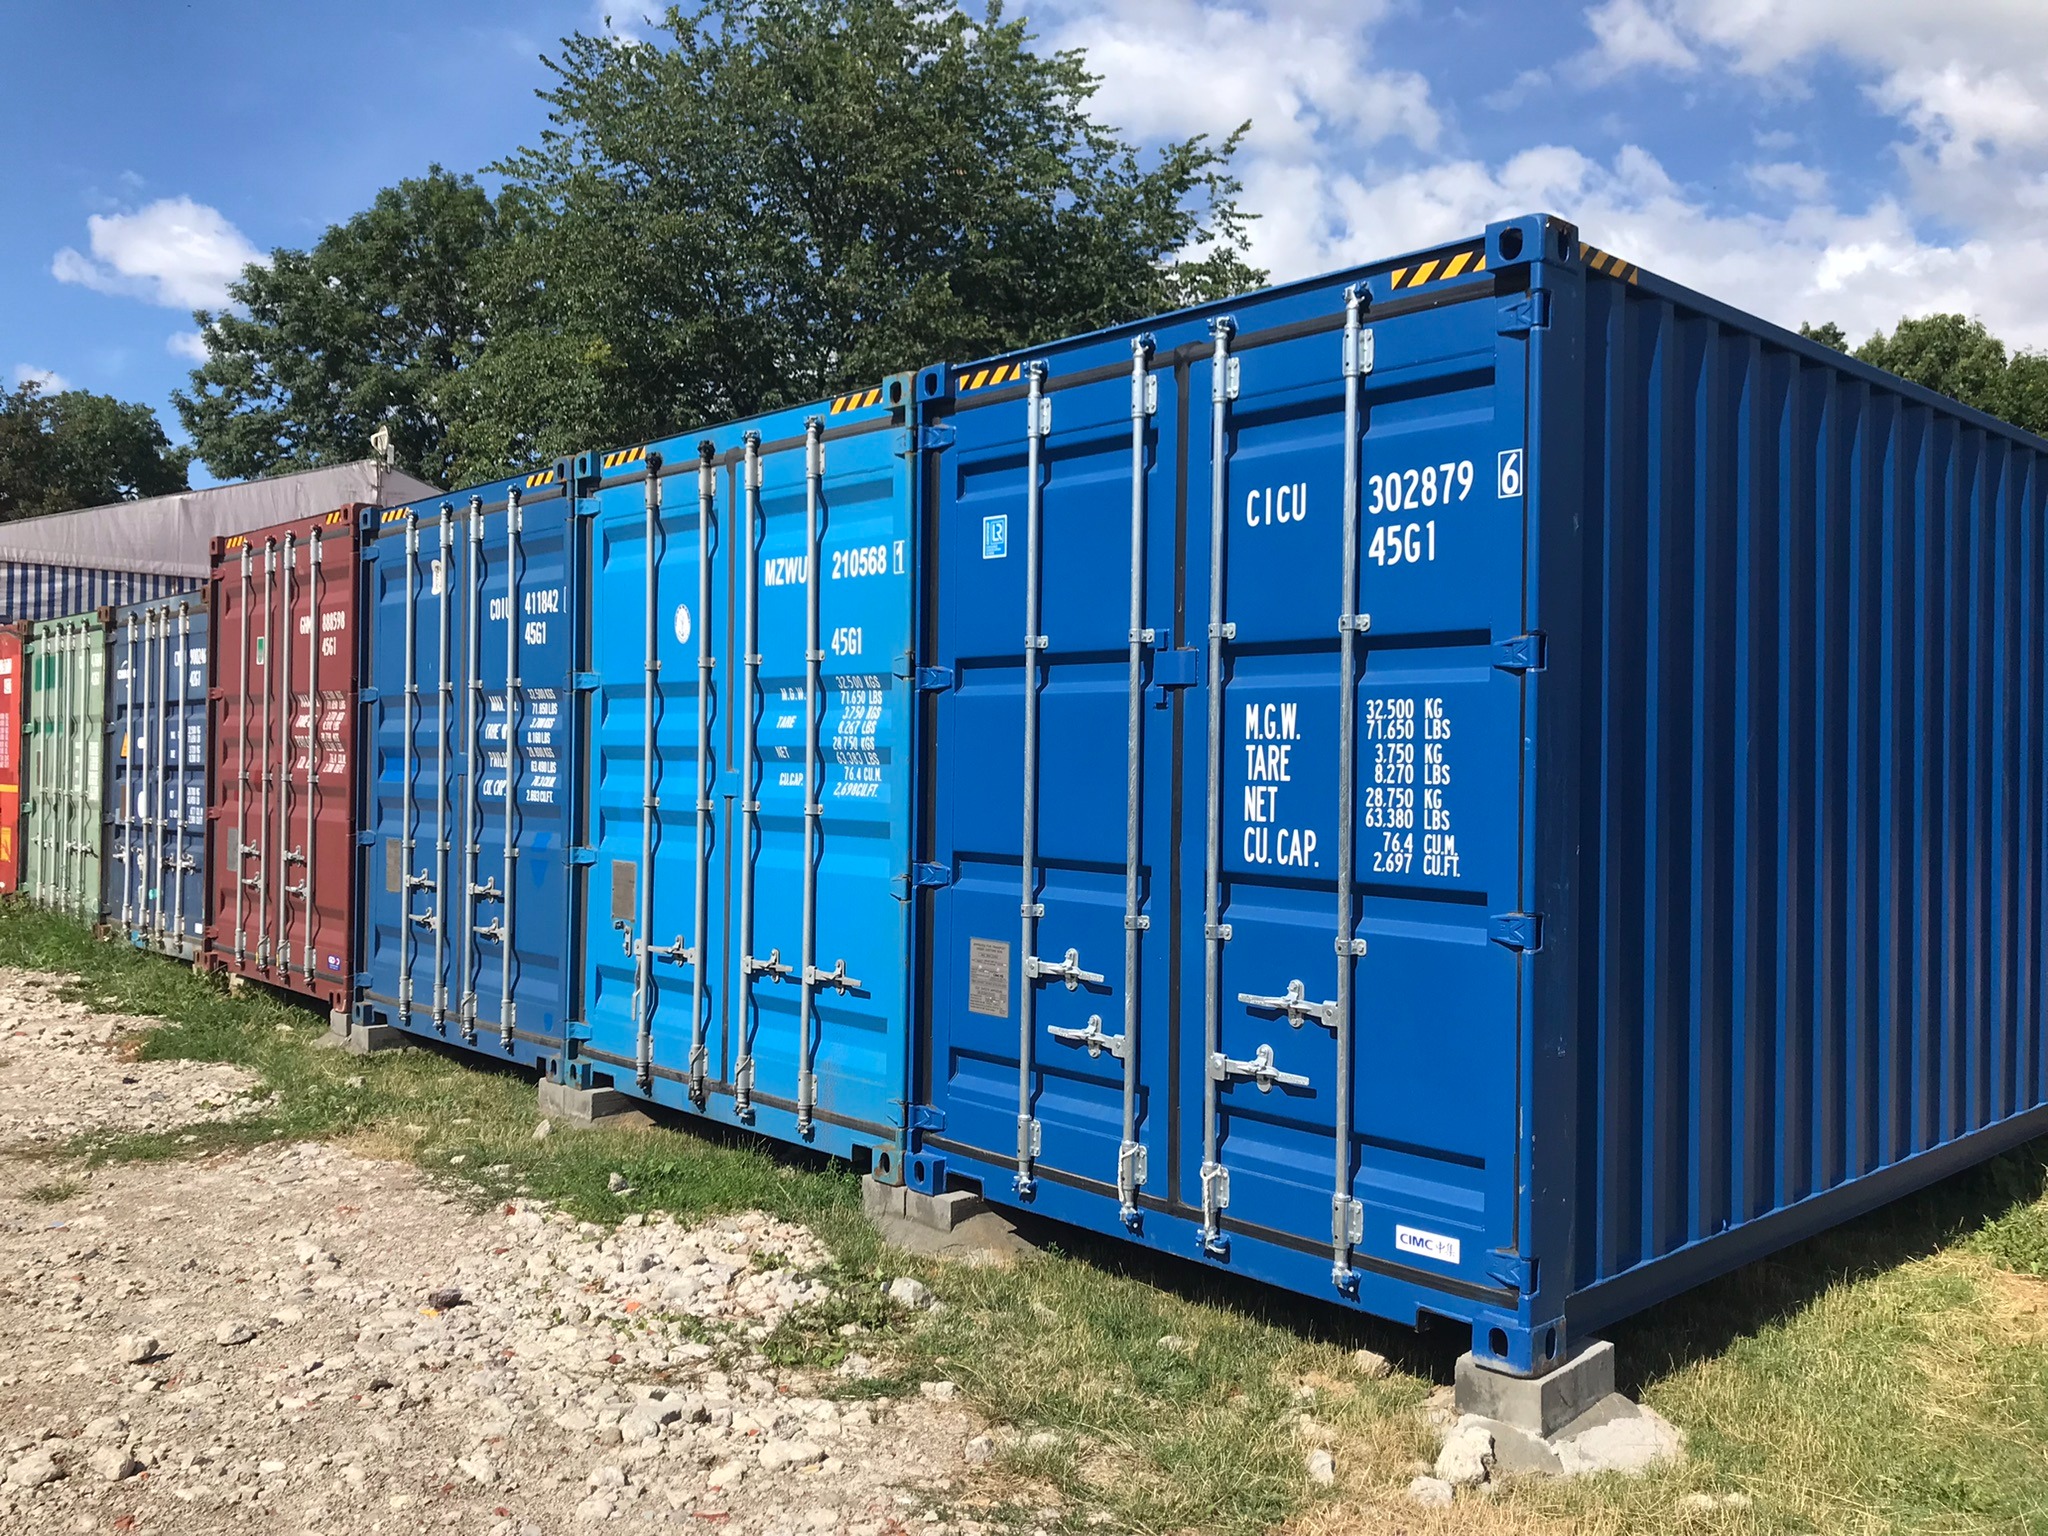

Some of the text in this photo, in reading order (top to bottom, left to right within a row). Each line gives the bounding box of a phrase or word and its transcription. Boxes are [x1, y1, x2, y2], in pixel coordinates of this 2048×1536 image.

[1246, 452, 1520, 527] CICU 302879 6
[1368, 520, 1436, 566] 45G1
[765, 555, 808, 586] MZWU
[832, 545, 887, 579] 210568
[525, 589, 559, 615] 411842
[525, 621, 546, 645] 45G1
[831, 627, 862, 655] 45G1
[863, 675, 881, 689] KGS
[781, 687, 807, 701] M.G.W.
[868, 690, 883, 705] LBS
[865, 706, 882, 720] KGS
[1366, 697, 1443, 719] 32,500 KG
[776, 715, 797, 729] TARE
[861, 721, 877, 734] LBS
[1245, 703, 1301, 740] M.G.W.
[1366, 719, 1451, 740] 71,650 LBS
[775, 746, 790, 758] NET
[860, 736, 875, 751] KGS
[1375, 743, 1443, 764] 3,750 KG
[864, 752, 880, 766] LBS
[1245, 744, 1292, 782] TARE
[844, 766, 861, 781] 76.4
[1375, 763, 1451, 785] 8,270 LBS
[1244, 786, 1278, 823] NET
[1365, 787, 1442, 809] 28,750 KG
[1365, 807, 1450, 831] 63,380 LBS
[1382, 831, 1459, 856] 76.4 CU.M.
[1373, 851, 1461, 878] 2,697 CU.FT.
[1400, 1233, 1433, 1251] CIMC
